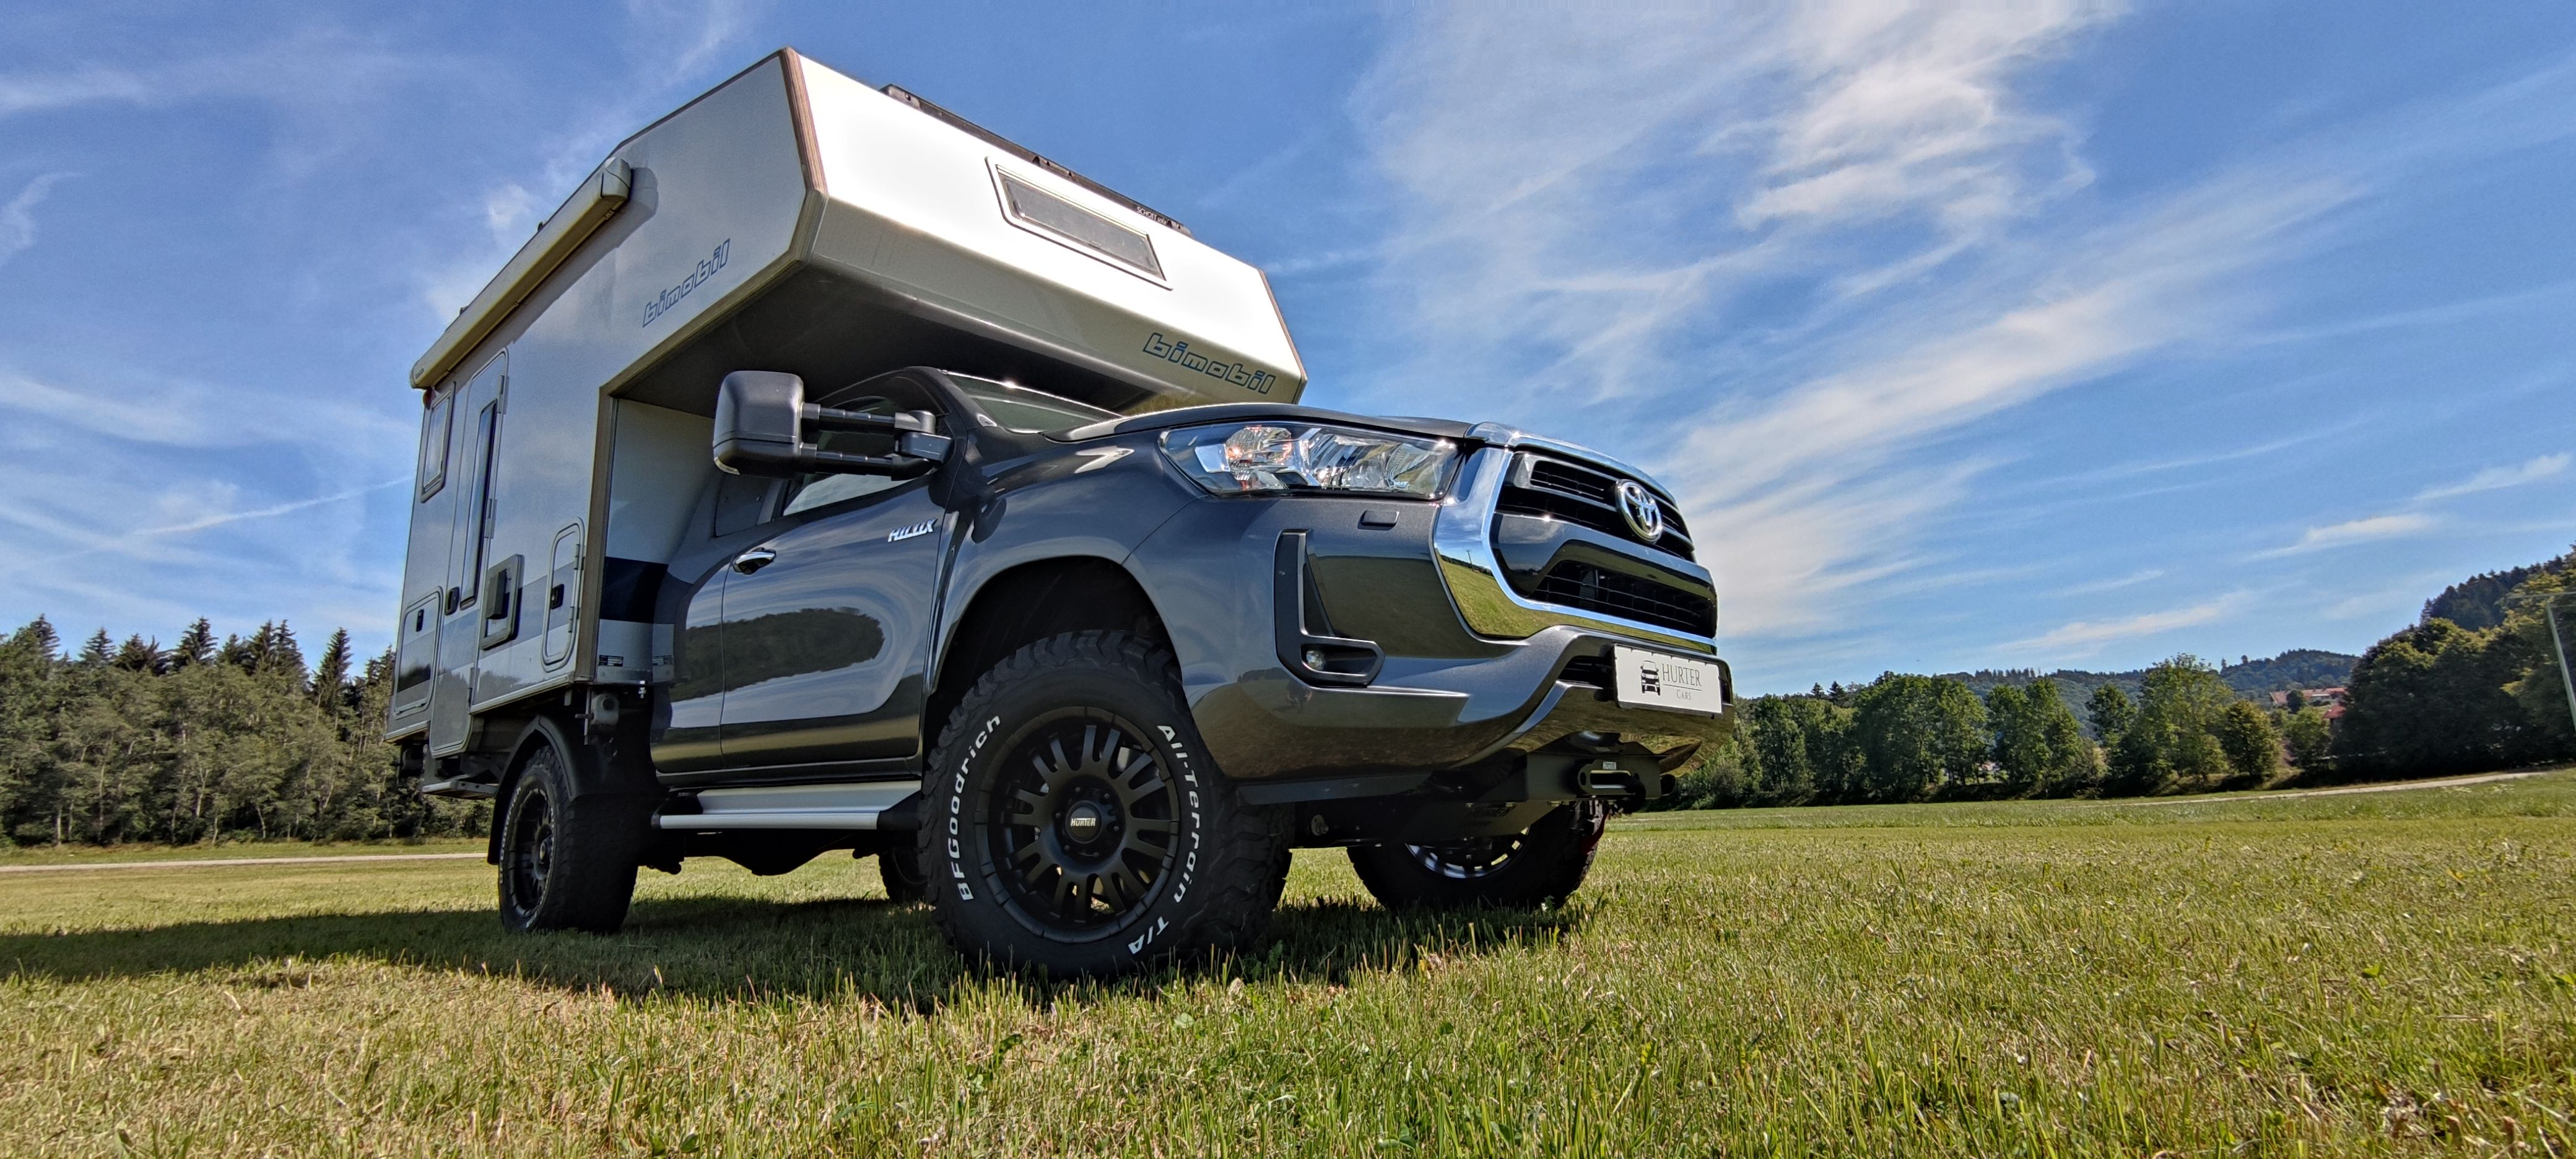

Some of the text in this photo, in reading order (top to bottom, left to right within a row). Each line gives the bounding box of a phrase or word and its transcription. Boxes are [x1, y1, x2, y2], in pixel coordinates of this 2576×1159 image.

[1137, 206, 1157, 221] SCHOTT
[643, 238, 729, 328] bimobil
[1142, 332, 1276, 394] bimobil
[888, 517, 939, 542] HILUX
[1661, 663, 1702, 687] HURTER
[947, 716, 1001, 901] BFGoodrich
[1071, 818, 1096, 827] HURTER
[1128, 724, 1199, 955] All-Terrain T/A
